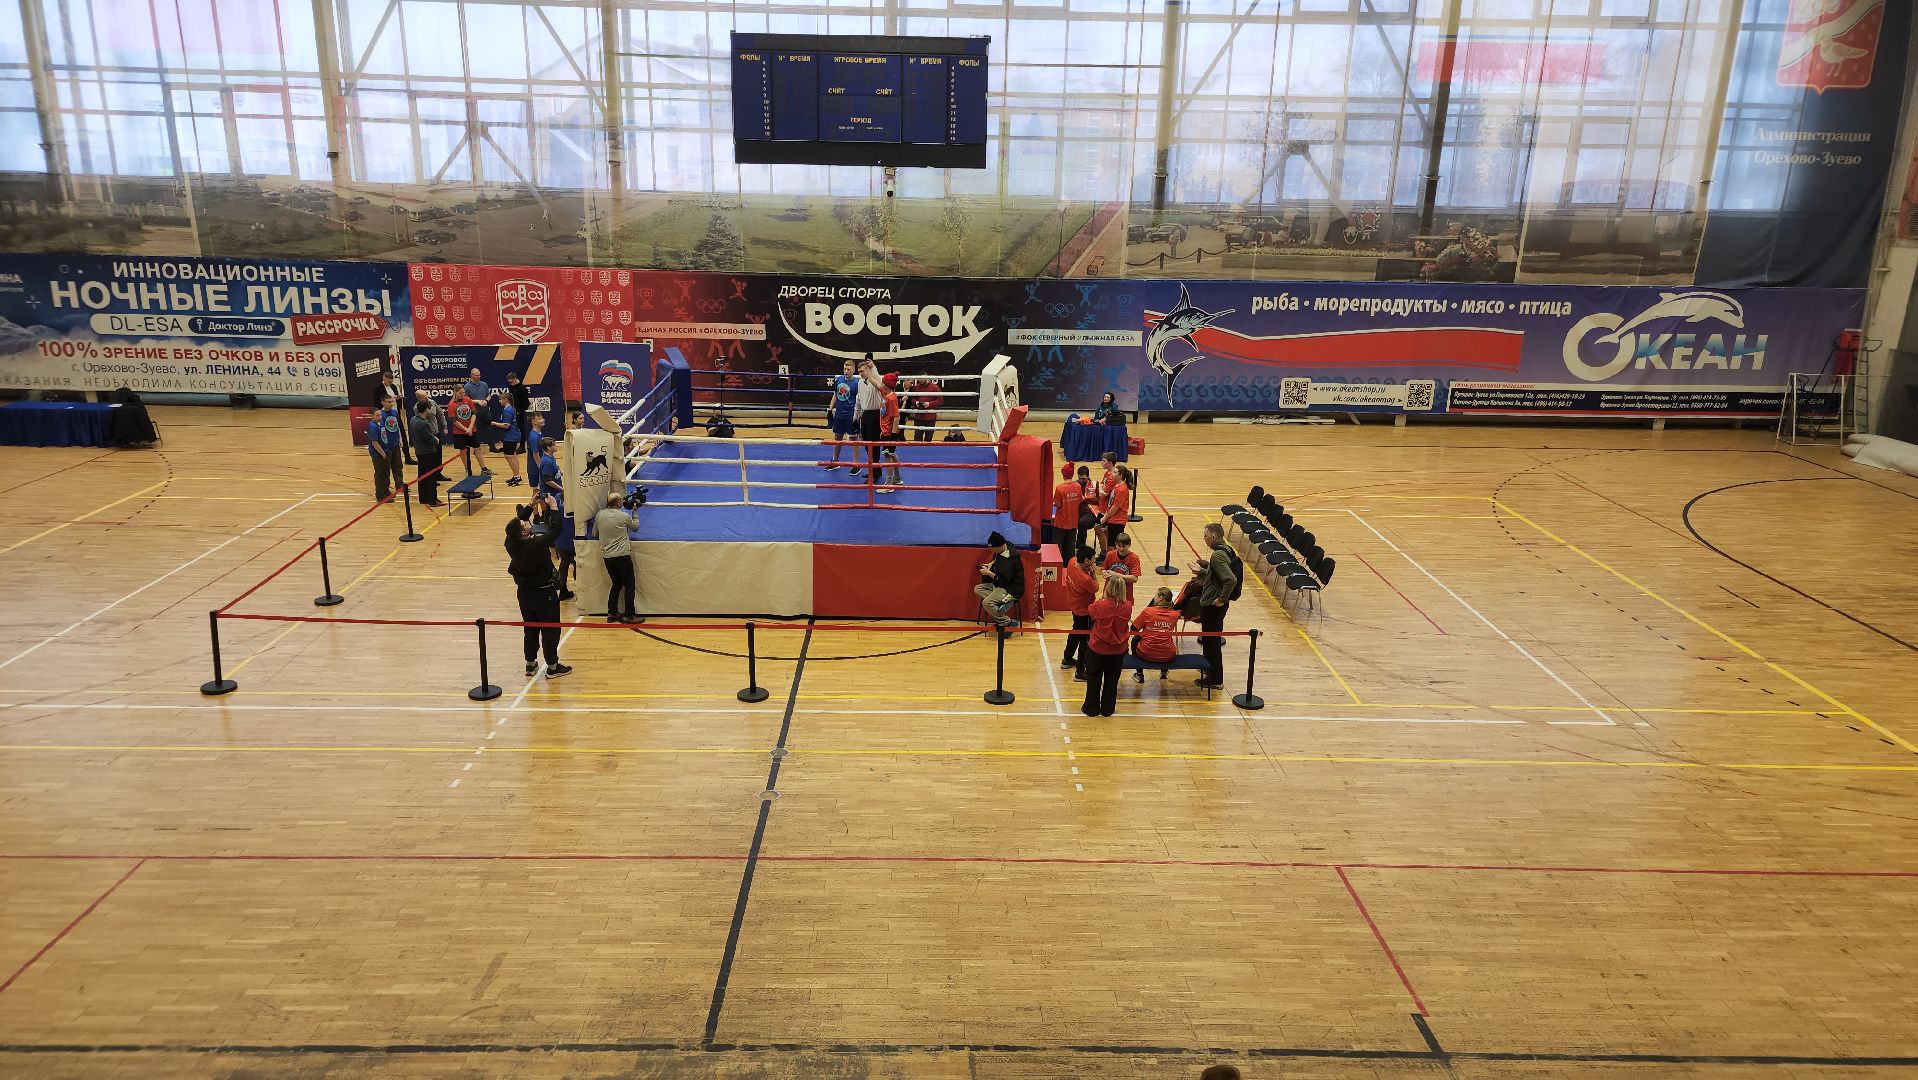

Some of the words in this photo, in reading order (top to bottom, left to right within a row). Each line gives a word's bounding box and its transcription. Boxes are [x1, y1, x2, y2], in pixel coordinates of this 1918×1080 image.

[834, 56, 863, 64] ИГРОВОЕ
[1754, 128, 1872, 144] Администрация
[1754, 150, 1862, 166] Орехово-Зуево
[112, 262, 325, 283] ИННОВАЦИОННЫЕ
[49, 280, 232, 312] НОЧНЫЕ
[244, 285, 392, 317] ЛИНЗЫ
[777, 285, 836, 300] ДВОРЕЦ
[838, 287, 891, 300] СПОРТА
[1252, 293, 1299, 315] рыба
[1313, 296, 1447, 317] морепродукты
[1460, 299, 1504, 314] мясо
[1519, 300, 1572, 317] птица
[110, 316, 183, 332] DL-ESA
[208, 321, 245, 333] Доктор
[296, 317, 380, 337] РАССРОЧКА
[805, 302, 983, 337] ВОСТОК
[1038, 333, 1076, 341] СЕВЕРНЫЙ
[39, 340, 98, 359] 100%
[102, 346, 169, 360] ЗРЕНИЕ
[173, 348, 204, 361] БЕЗ
[208, 350, 264, 362] ОЧКОВ
[268, 351, 280, 362] И
[285, 351, 315, 363] БЕЗ
[184, 366, 202, 376] ул.
[205, 365, 264, 378] ЛЕНИНА,
[267, 366, 281, 376] 44
[314, 365, 342, 378] (496)
[189, 379, 303, 392] КОНСУЛЬТАЦИЯ
[1319, 385, 1386, 394] www.okeanshop.ru
